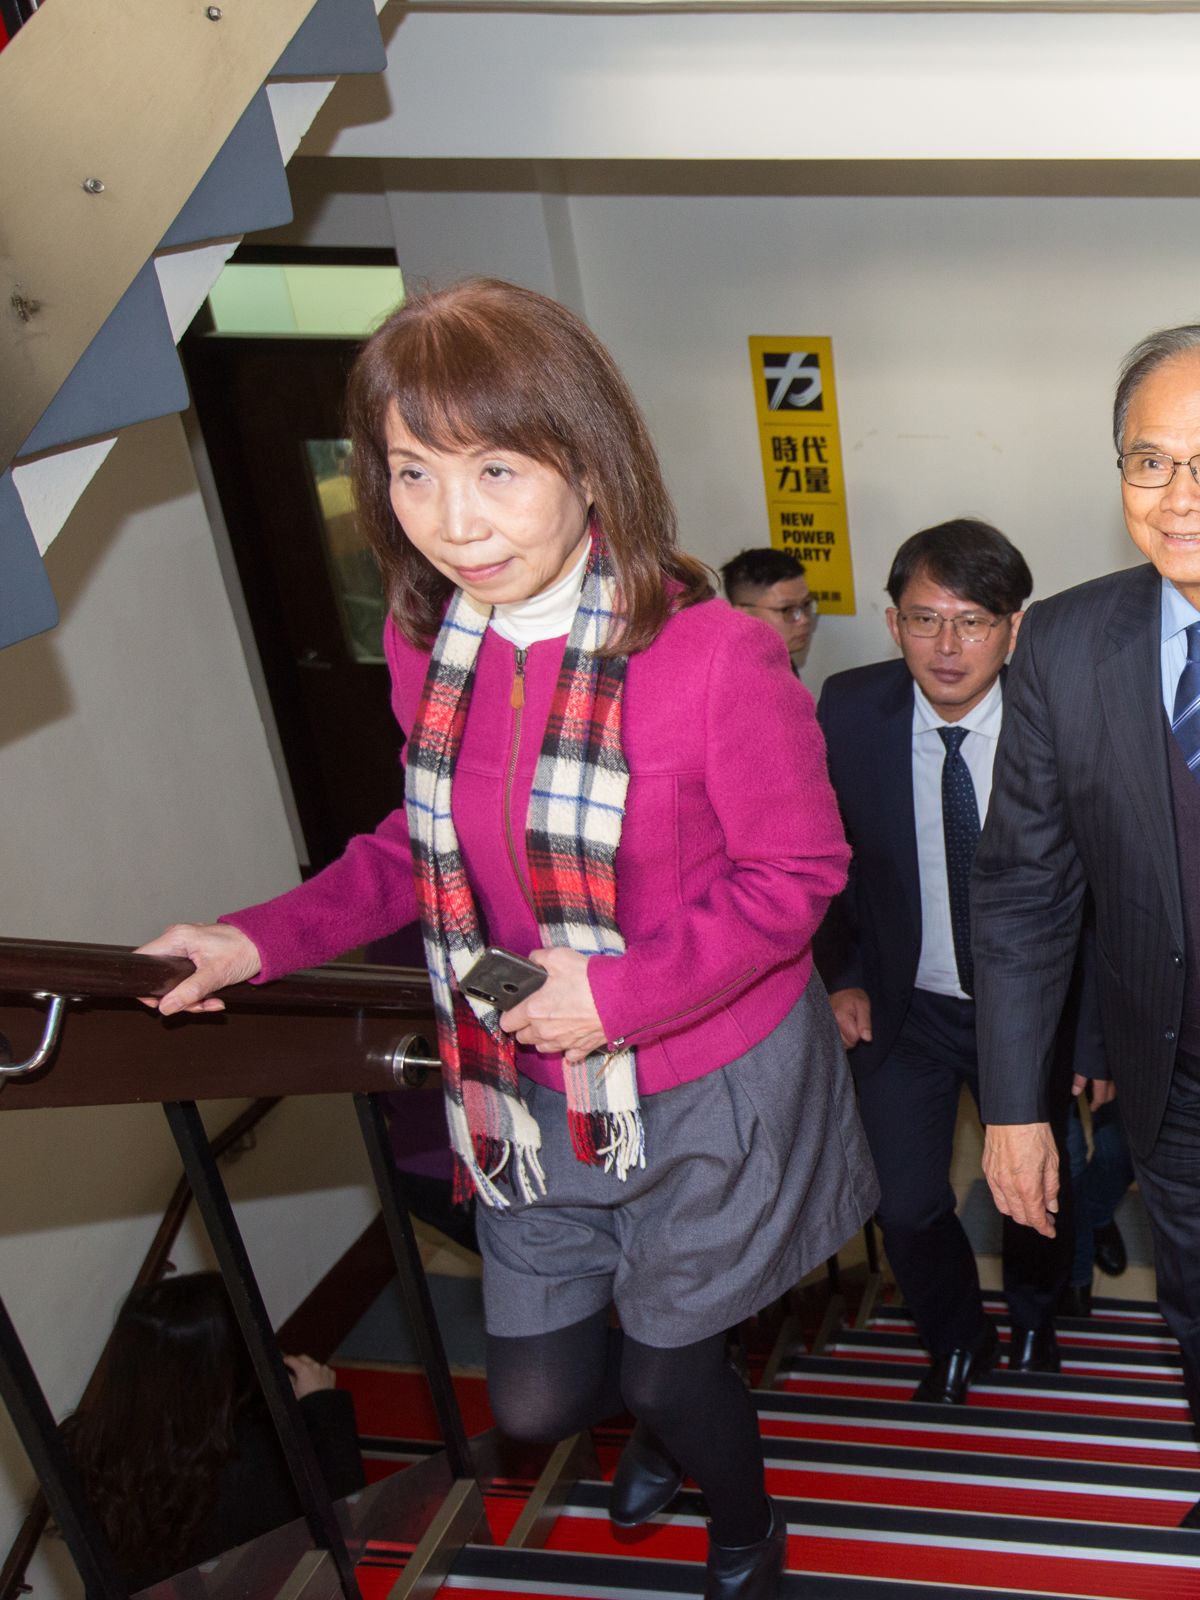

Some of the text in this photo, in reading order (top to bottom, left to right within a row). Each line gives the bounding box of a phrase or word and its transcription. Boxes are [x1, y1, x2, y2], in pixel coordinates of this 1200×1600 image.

[772, 436, 828, 464] 時代
[776, 466, 831, 494] 力量
[781, 512, 814, 527] NEW
[782, 530, 835, 545] POWER
